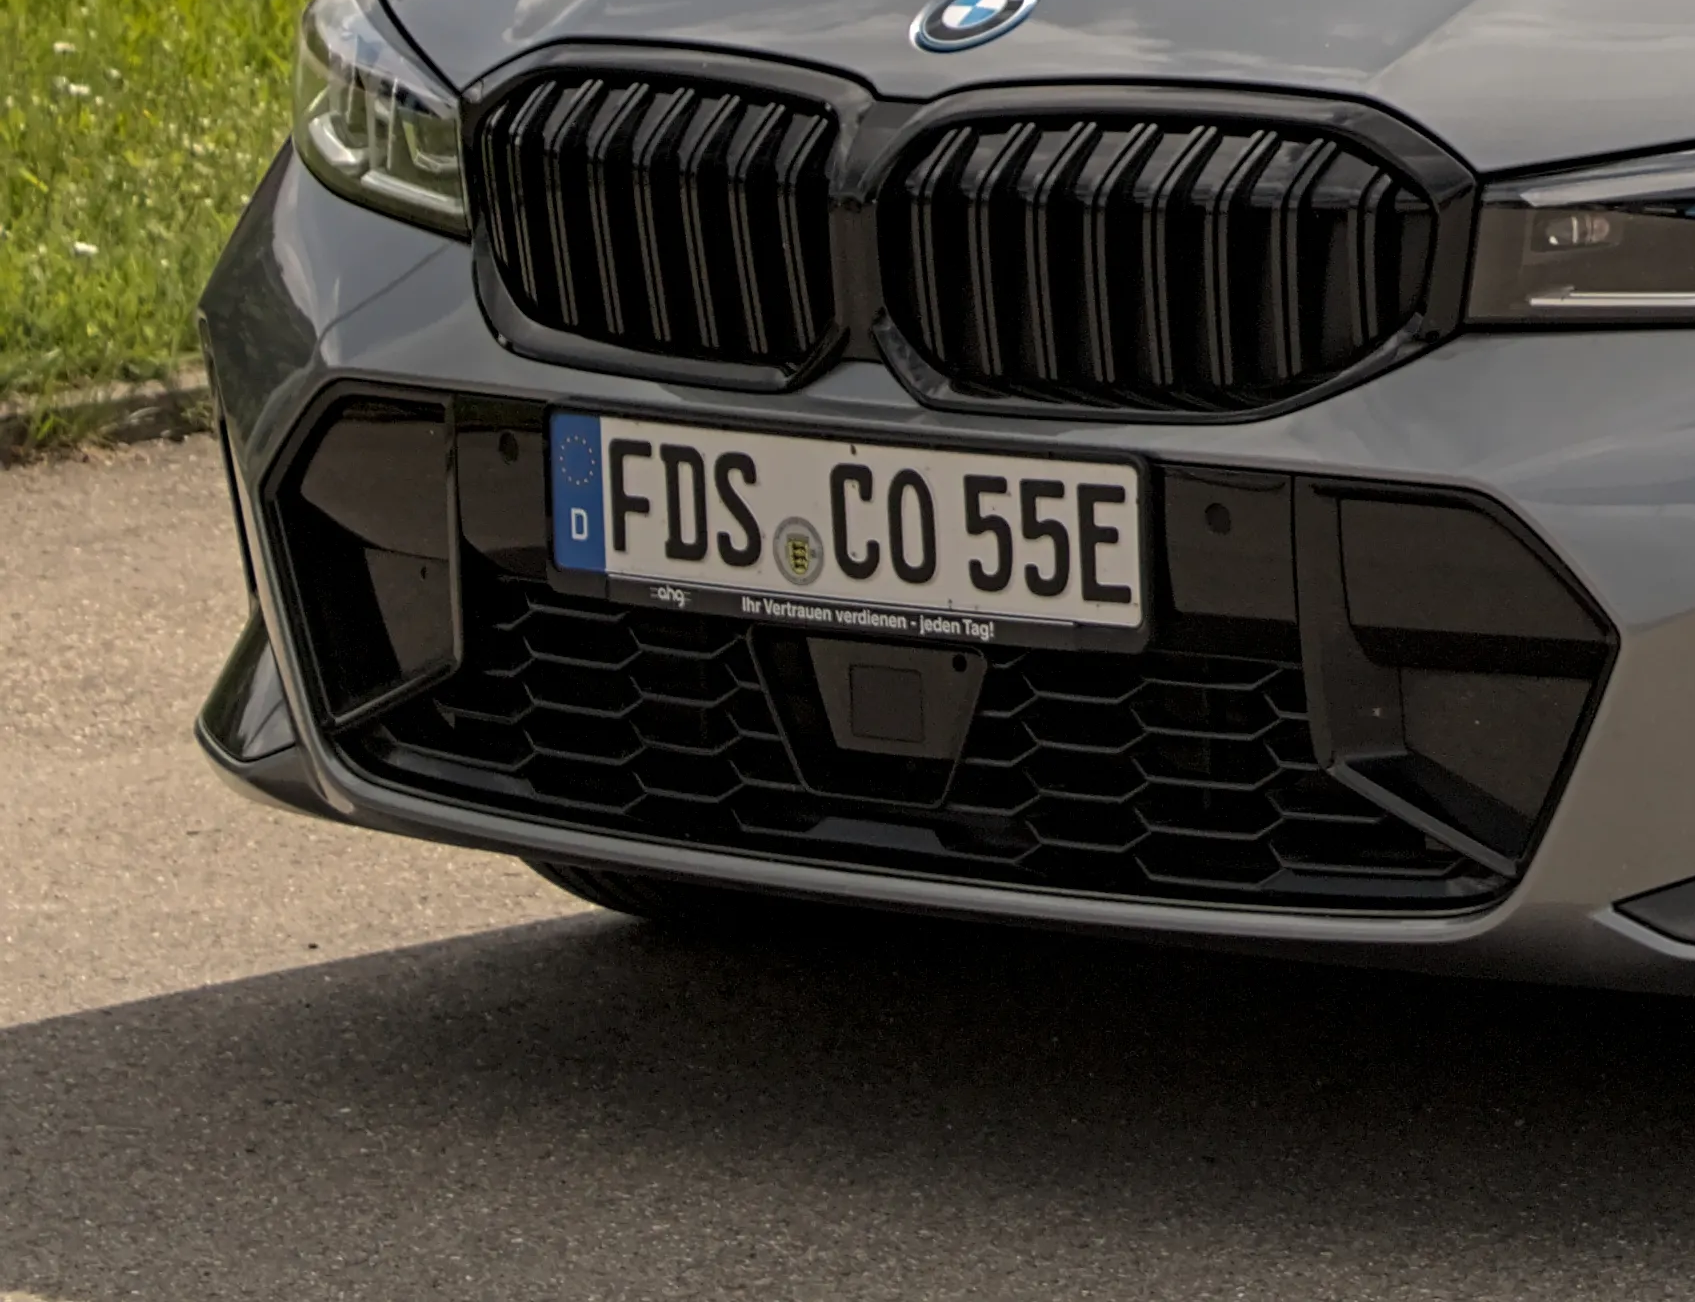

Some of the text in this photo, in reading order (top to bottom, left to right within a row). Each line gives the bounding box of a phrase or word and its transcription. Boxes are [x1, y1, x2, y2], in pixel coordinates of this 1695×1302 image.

[570, 507, 588, 542] D
[607, 437, 1134, 605] FDS CO 55E
[657, 584, 686, 608] ahg
[740, 596, 760, 614] Ihr
[762, 598, 833, 622] Vertrauen
[834, 609, 908, 630] verdienen
[919, 614, 961, 636] jeden
[963, 619, 996, 641] Tag!
